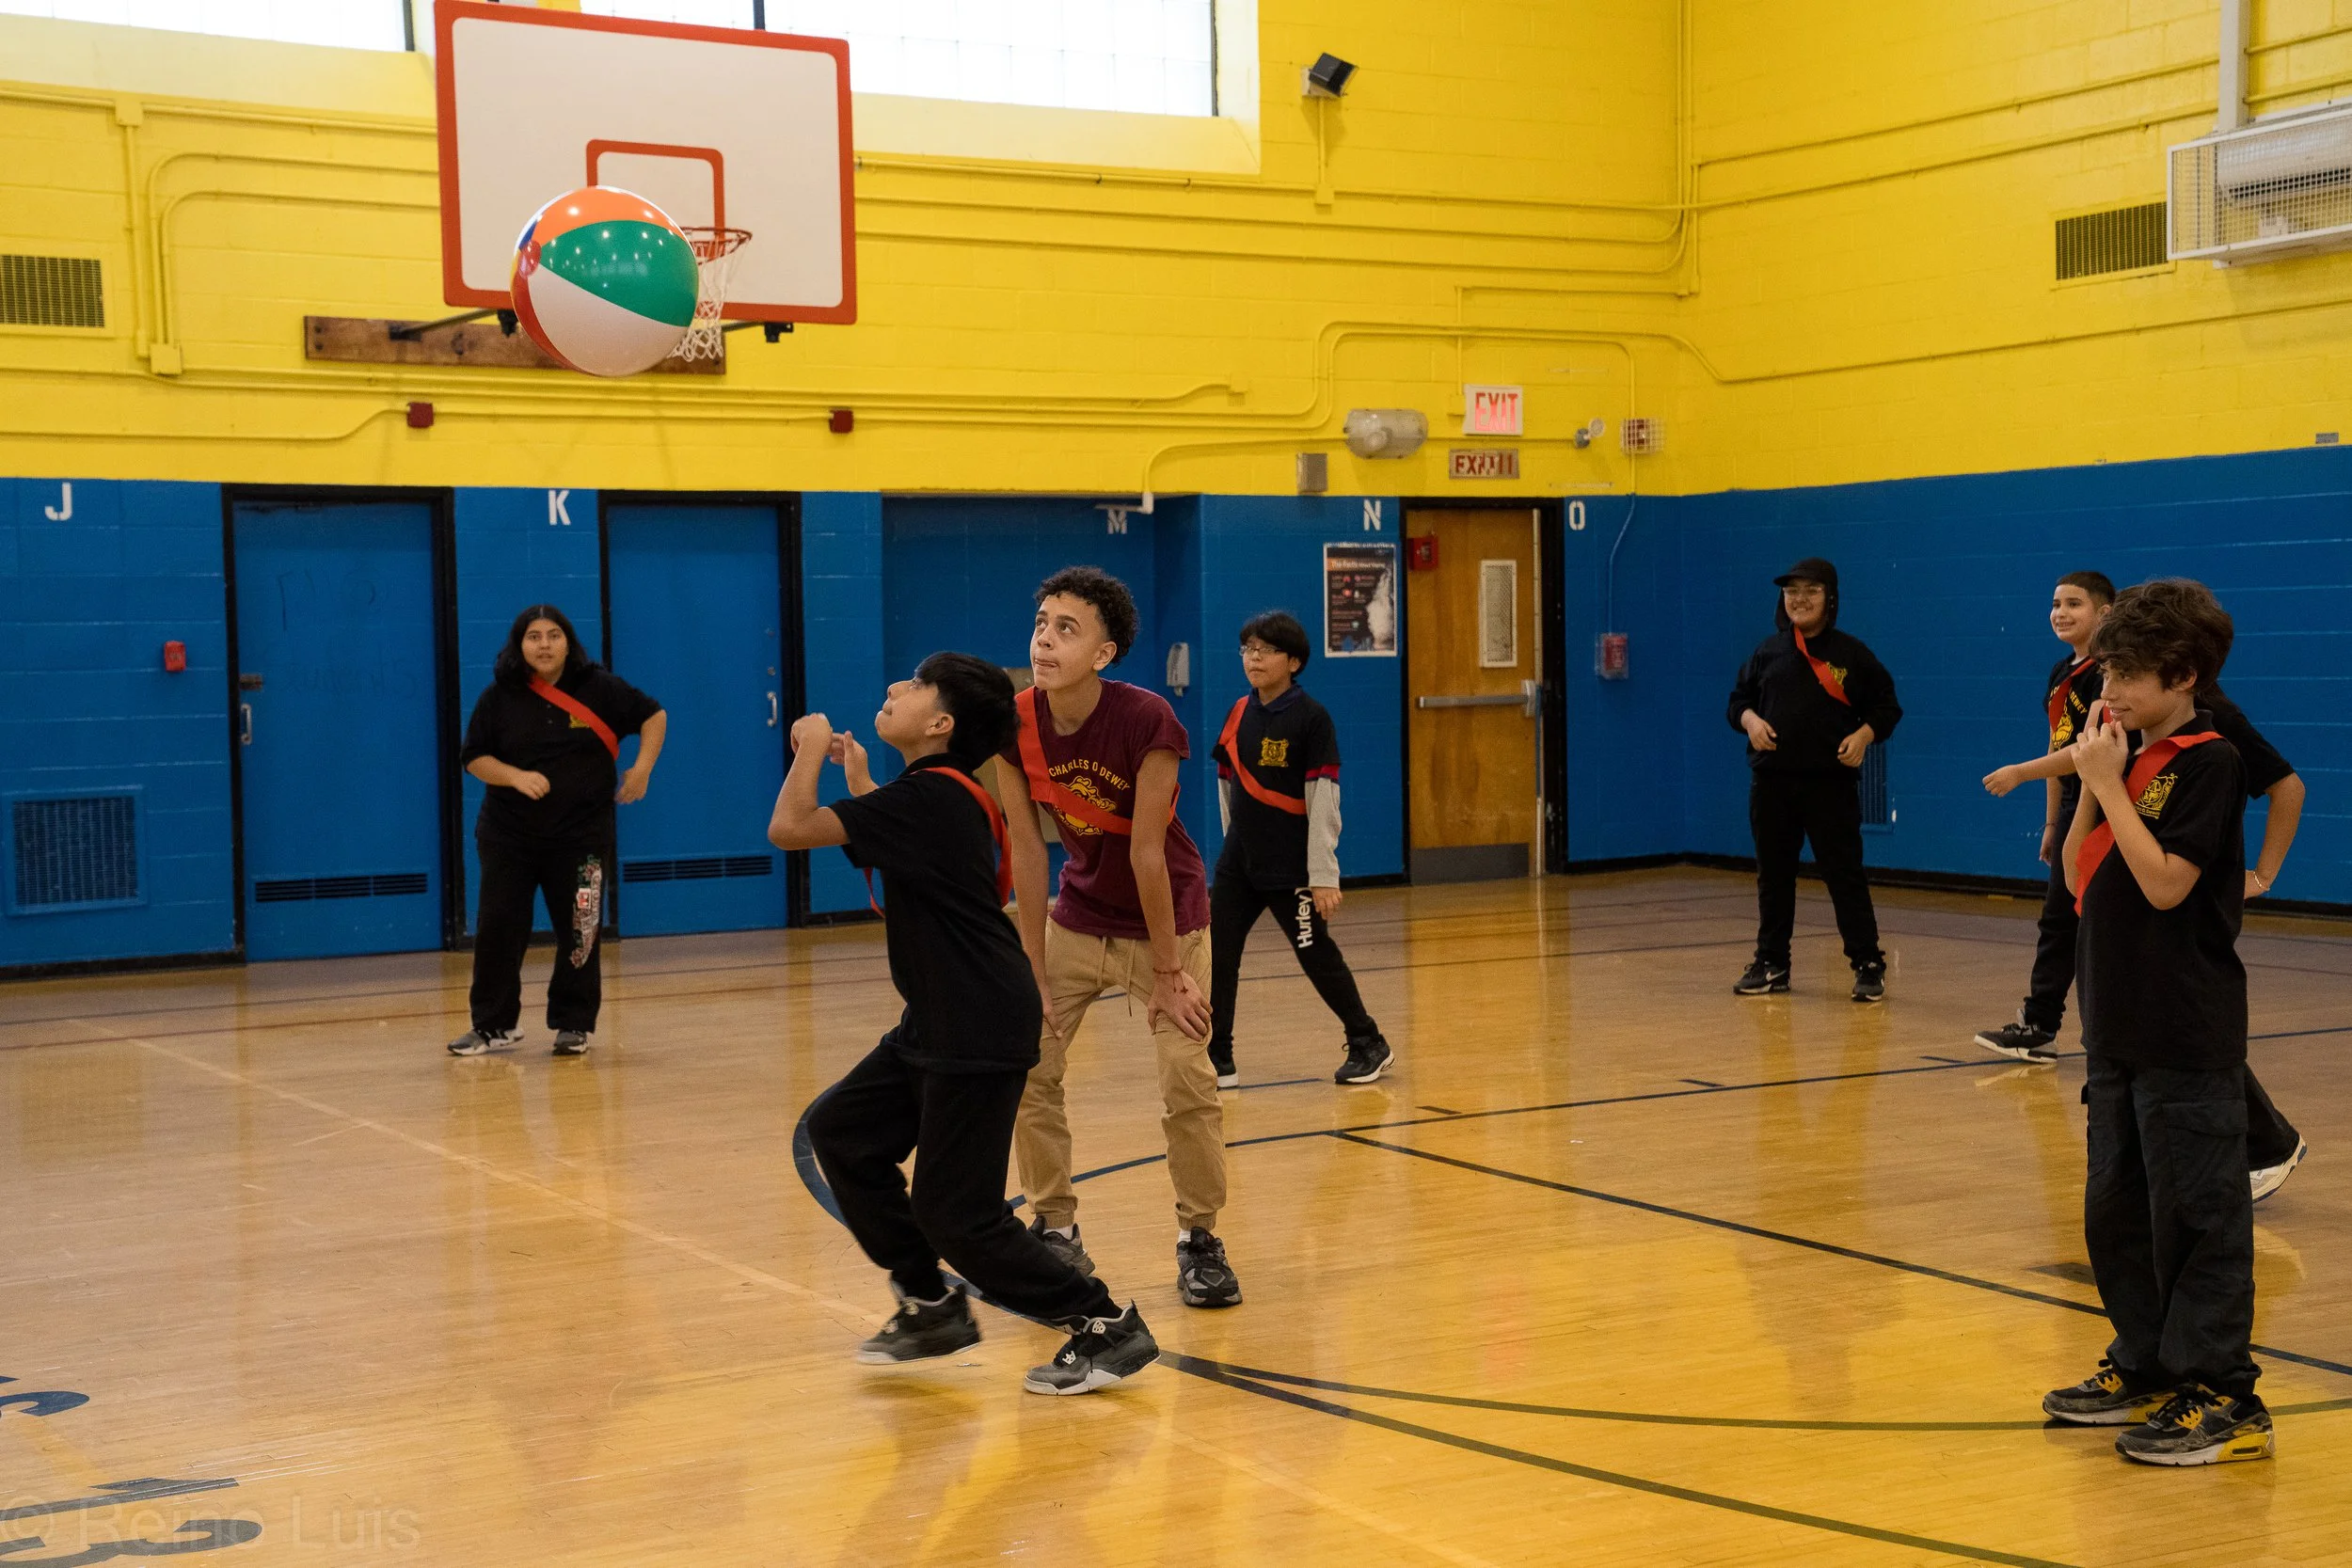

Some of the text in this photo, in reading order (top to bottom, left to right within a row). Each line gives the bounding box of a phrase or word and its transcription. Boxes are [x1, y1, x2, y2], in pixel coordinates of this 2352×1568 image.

[1475, 391, 1518, 432] EXIT
[44, 482, 72, 521] J
[548, 489, 571, 526] K
[1363, 499, 1381, 531] N
[1107, 510, 1128, 535] M
[1048, 758, 1089, 776] CHARLES
[1099, 767, 1130, 791] DEWEY
[1295, 895, 1313, 948] Hurley
